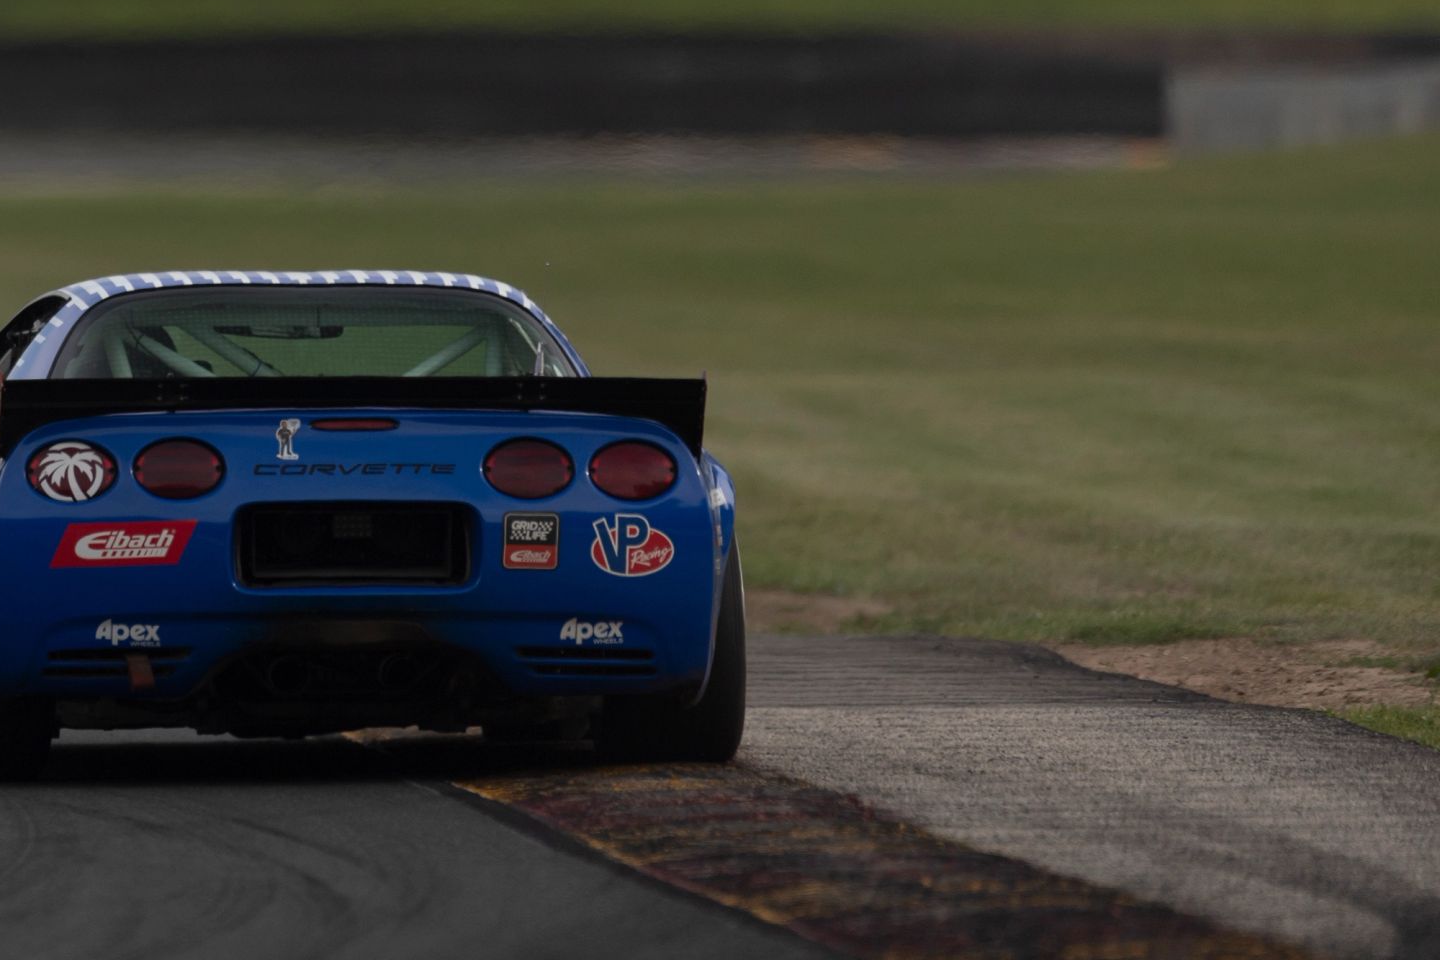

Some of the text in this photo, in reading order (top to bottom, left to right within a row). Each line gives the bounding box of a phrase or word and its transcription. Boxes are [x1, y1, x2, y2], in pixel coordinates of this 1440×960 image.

[253, 463, 456, 476] CORVETTE
[511, 520, 538, 530] GRID
[526, 531, 549, 541] LIFE
[74, 528, 174, 560] Eibach
[592, 513, 651, 576] VP
[630, 547, 672, 569] Racing
[95, 618, 160, 646] Apex
[560, 617, 623, 645] Apex
